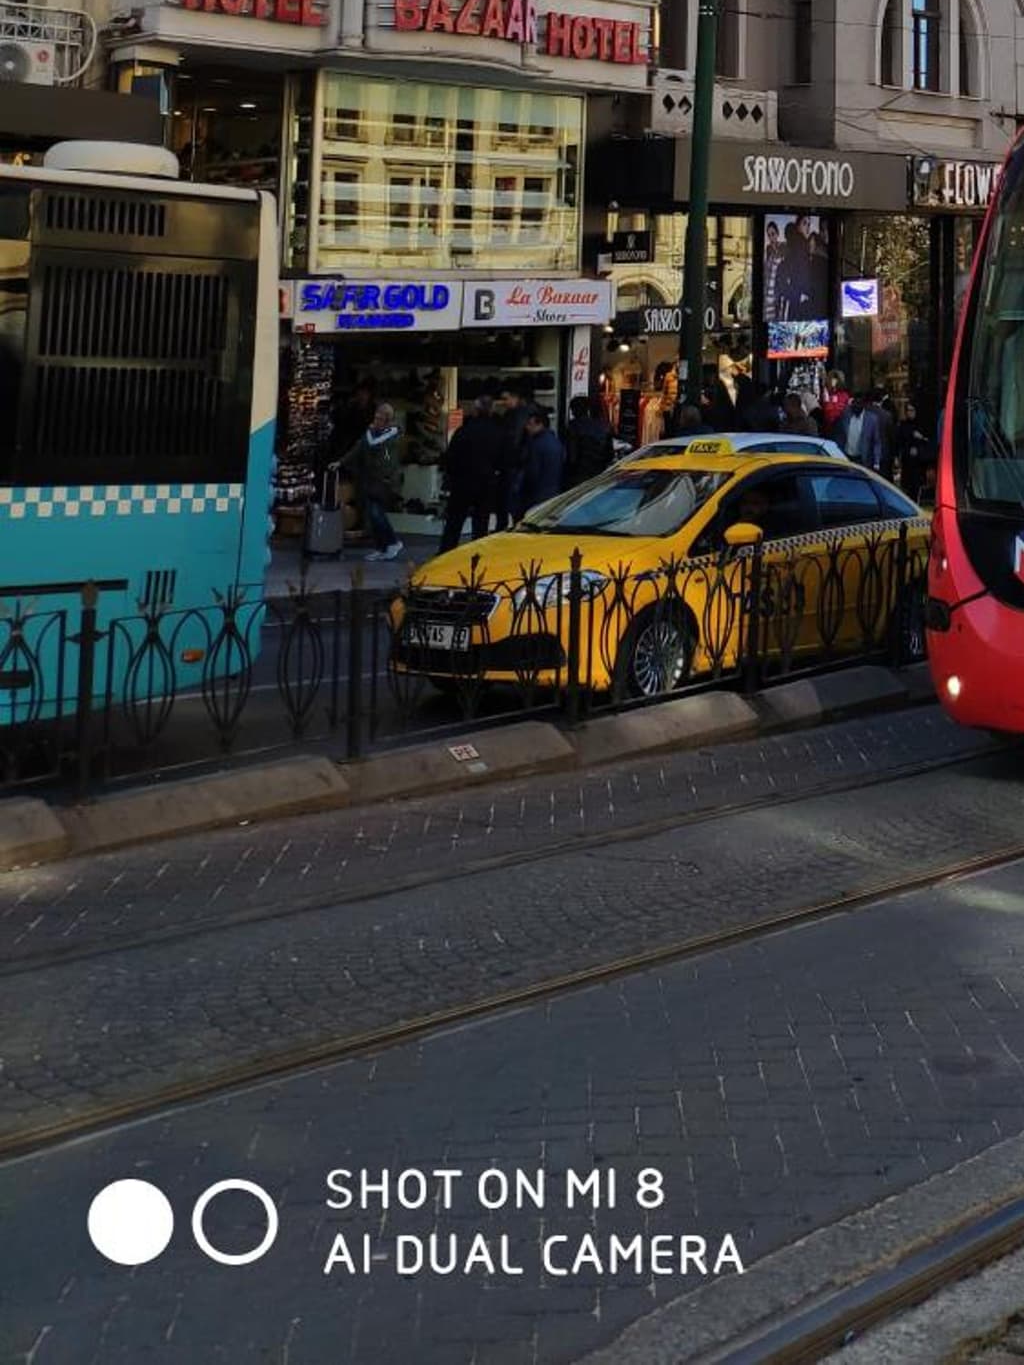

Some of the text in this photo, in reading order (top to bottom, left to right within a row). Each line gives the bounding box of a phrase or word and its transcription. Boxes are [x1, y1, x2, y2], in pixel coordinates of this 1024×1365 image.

[546, 10, 648, 65] HOTEL
[383, 284, 449, 311] GOLD
[506, 285, 531, 305] La
